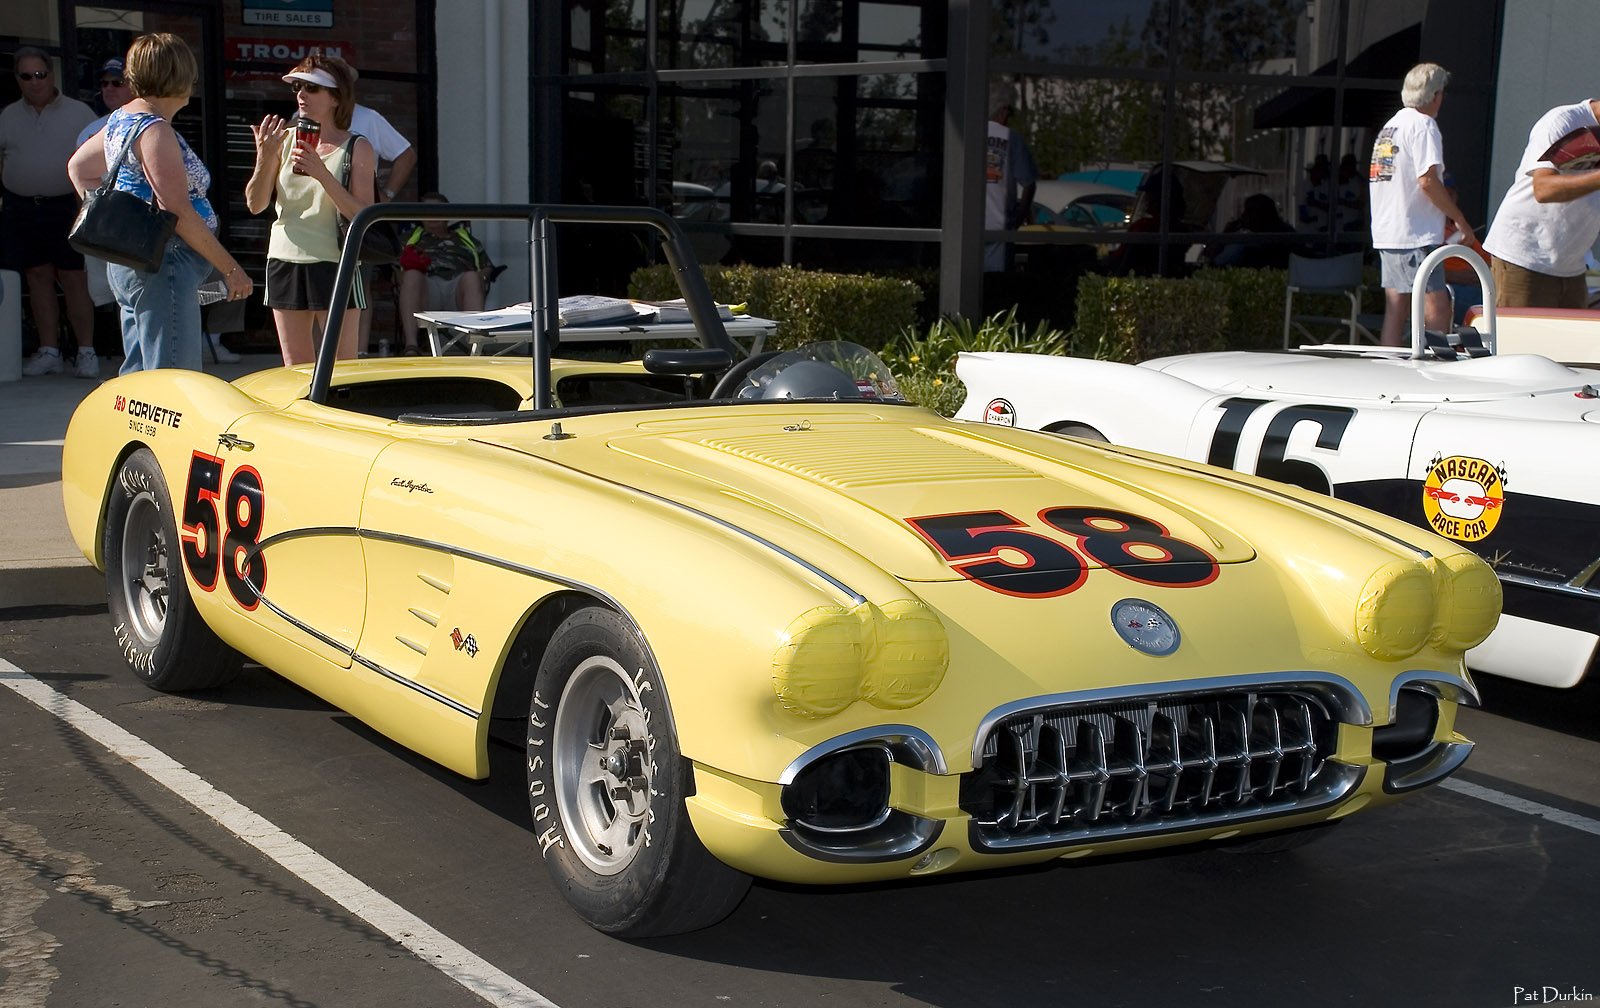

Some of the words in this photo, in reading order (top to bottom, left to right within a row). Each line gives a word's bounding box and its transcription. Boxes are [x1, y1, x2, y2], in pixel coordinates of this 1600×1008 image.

[255, 12, 280, 22] TIRE
[286, 14, 321, 23] SALES
[237, 43, 342, 60] TROJAN
[129, 399, 182, 428] CORVETTE
[129, 419, 143, 434] SINCE
[1208, 397, 1355, 496] 16
[1435, 459, 1497, 493] NASCAR
[181, 449, 268, 612] 58
[1432, 512, 1460, 536] RACE
[1464, 520, 1488, 538] CAR
[903, 505, 1221, 599] 58
[528, 690, 565, 859] Hoosier
